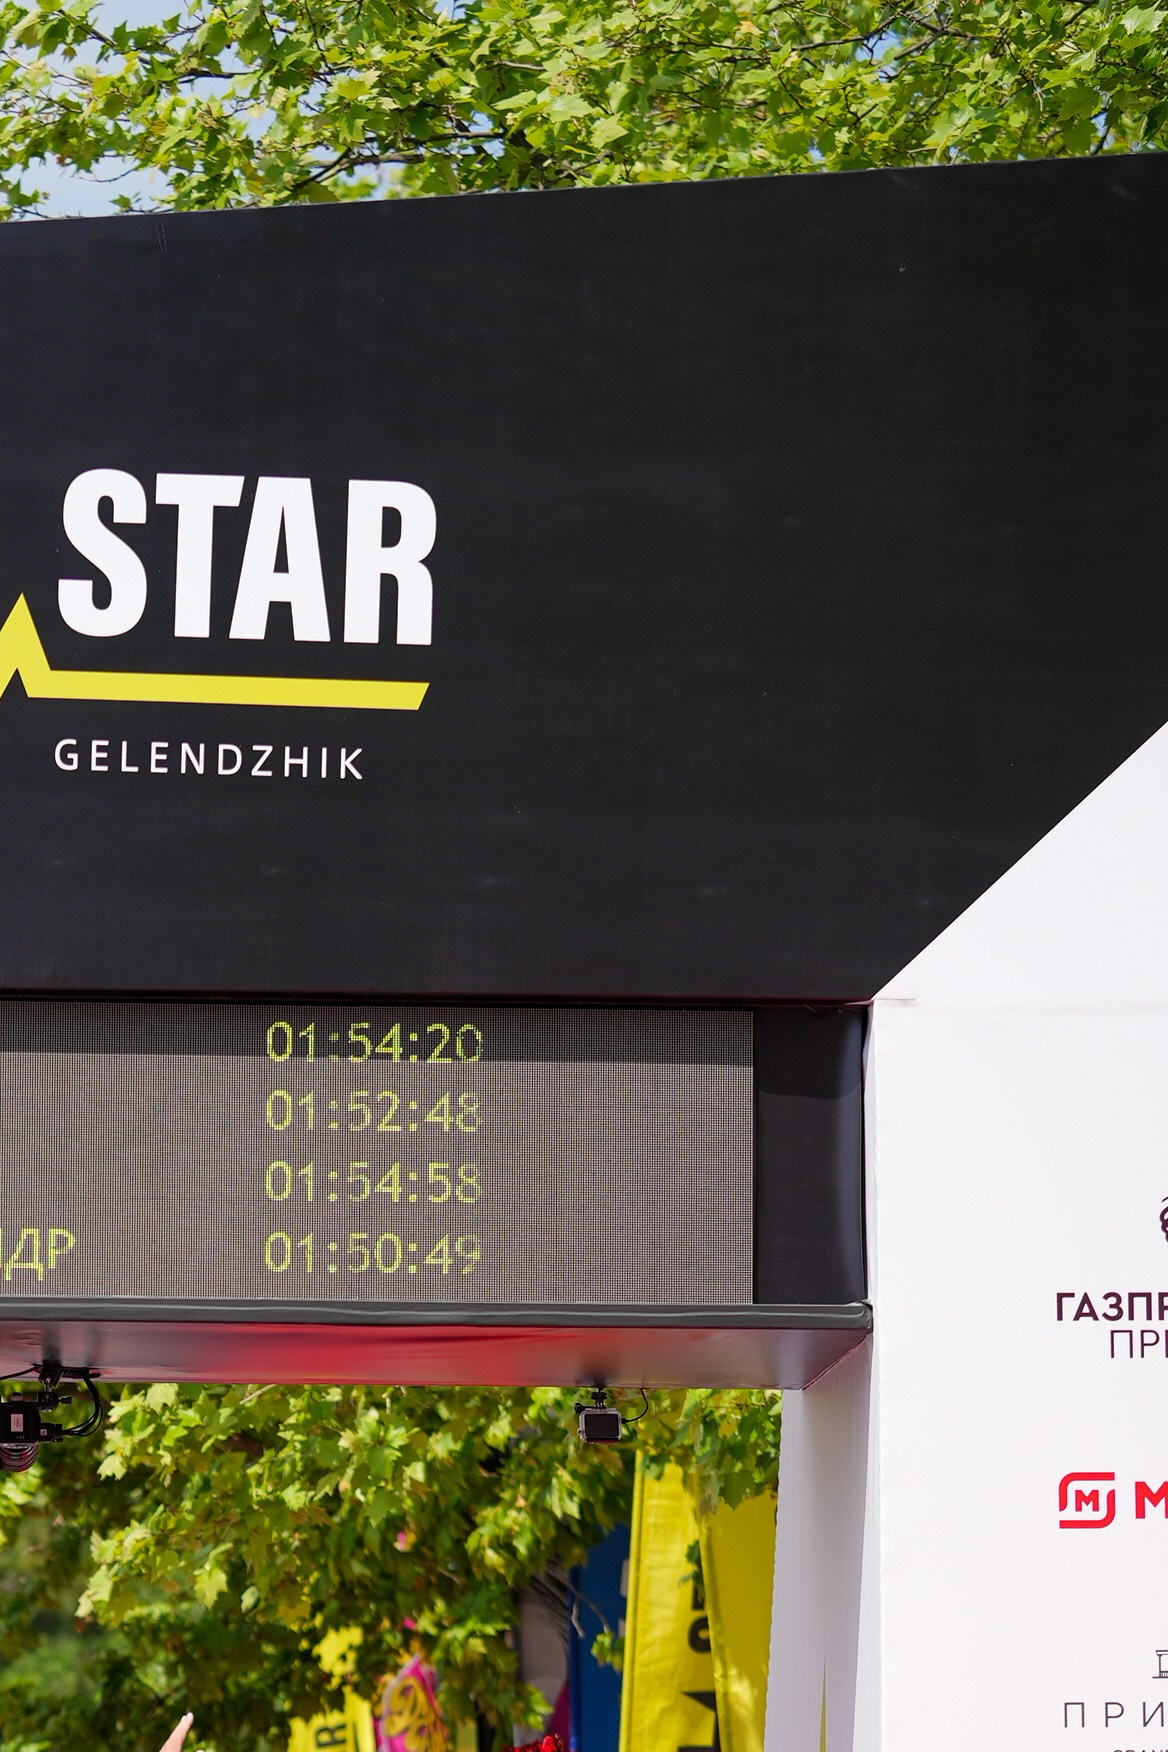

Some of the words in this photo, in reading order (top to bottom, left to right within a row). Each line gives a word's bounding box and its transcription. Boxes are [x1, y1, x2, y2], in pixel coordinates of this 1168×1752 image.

[57, 468, 437, 646] STAR
[54, 738, 364, 780] GELENDZHIK
[266, 1020, 483, 1063] 01:54:20
[266, 1089, 481, 1132] 01:52:48
[265, 1160, 482, 1203] 01:54:58
[264, 1231, 481, 1274] 01:50:49
